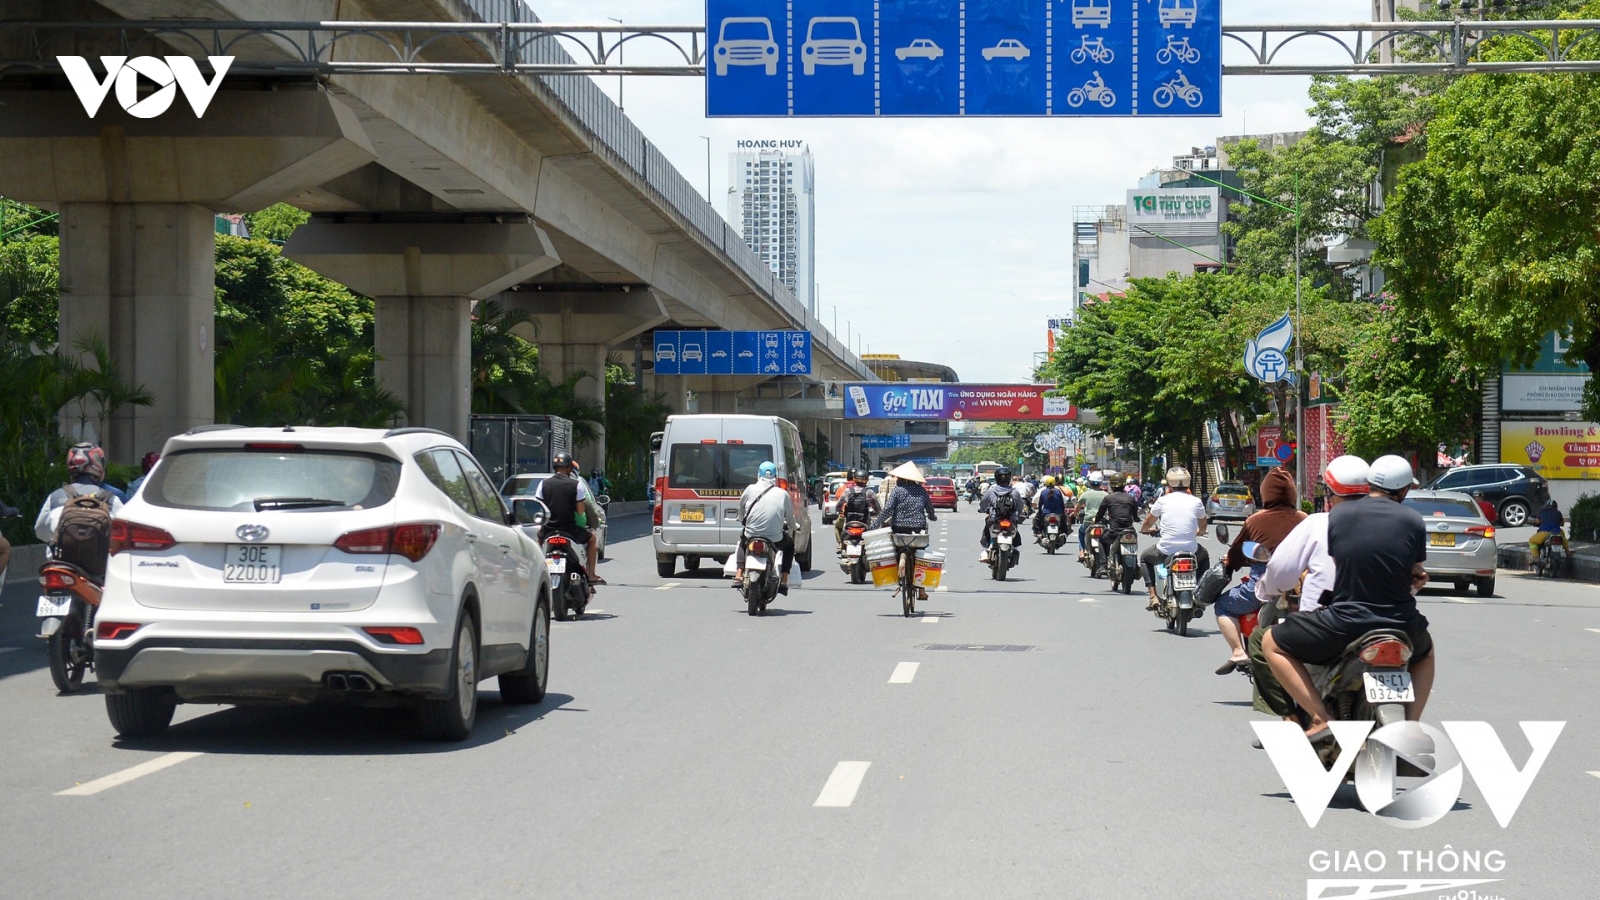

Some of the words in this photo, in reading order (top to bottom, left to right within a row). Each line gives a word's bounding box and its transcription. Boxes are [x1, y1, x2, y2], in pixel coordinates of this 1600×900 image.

[780, 140, 802, 148] HUY
[1159, 200, 1181, 210] THU
[882, 391, 908, 411] Gọi
[910, 389, 944, 410] TAXI
[960, 390, 975, 398] ỨNG
[976, 391, 995, 400] DỤNG
[997, 390, 1016, 398] NGÂN
[1017, 390, 1037, 398] HÀNG
[1534, 426, 1583, 438] Bowling
[1587, 427, 1596, 436] &
[1568, 443, 1588, 453] Tầng
[239, 546, 269, 563] 30E
[226, 565, 277, 581] 220.01
[1372, 674, 1404, 687] 19-C1
[1370, 688, 1410, 700] 032.47
